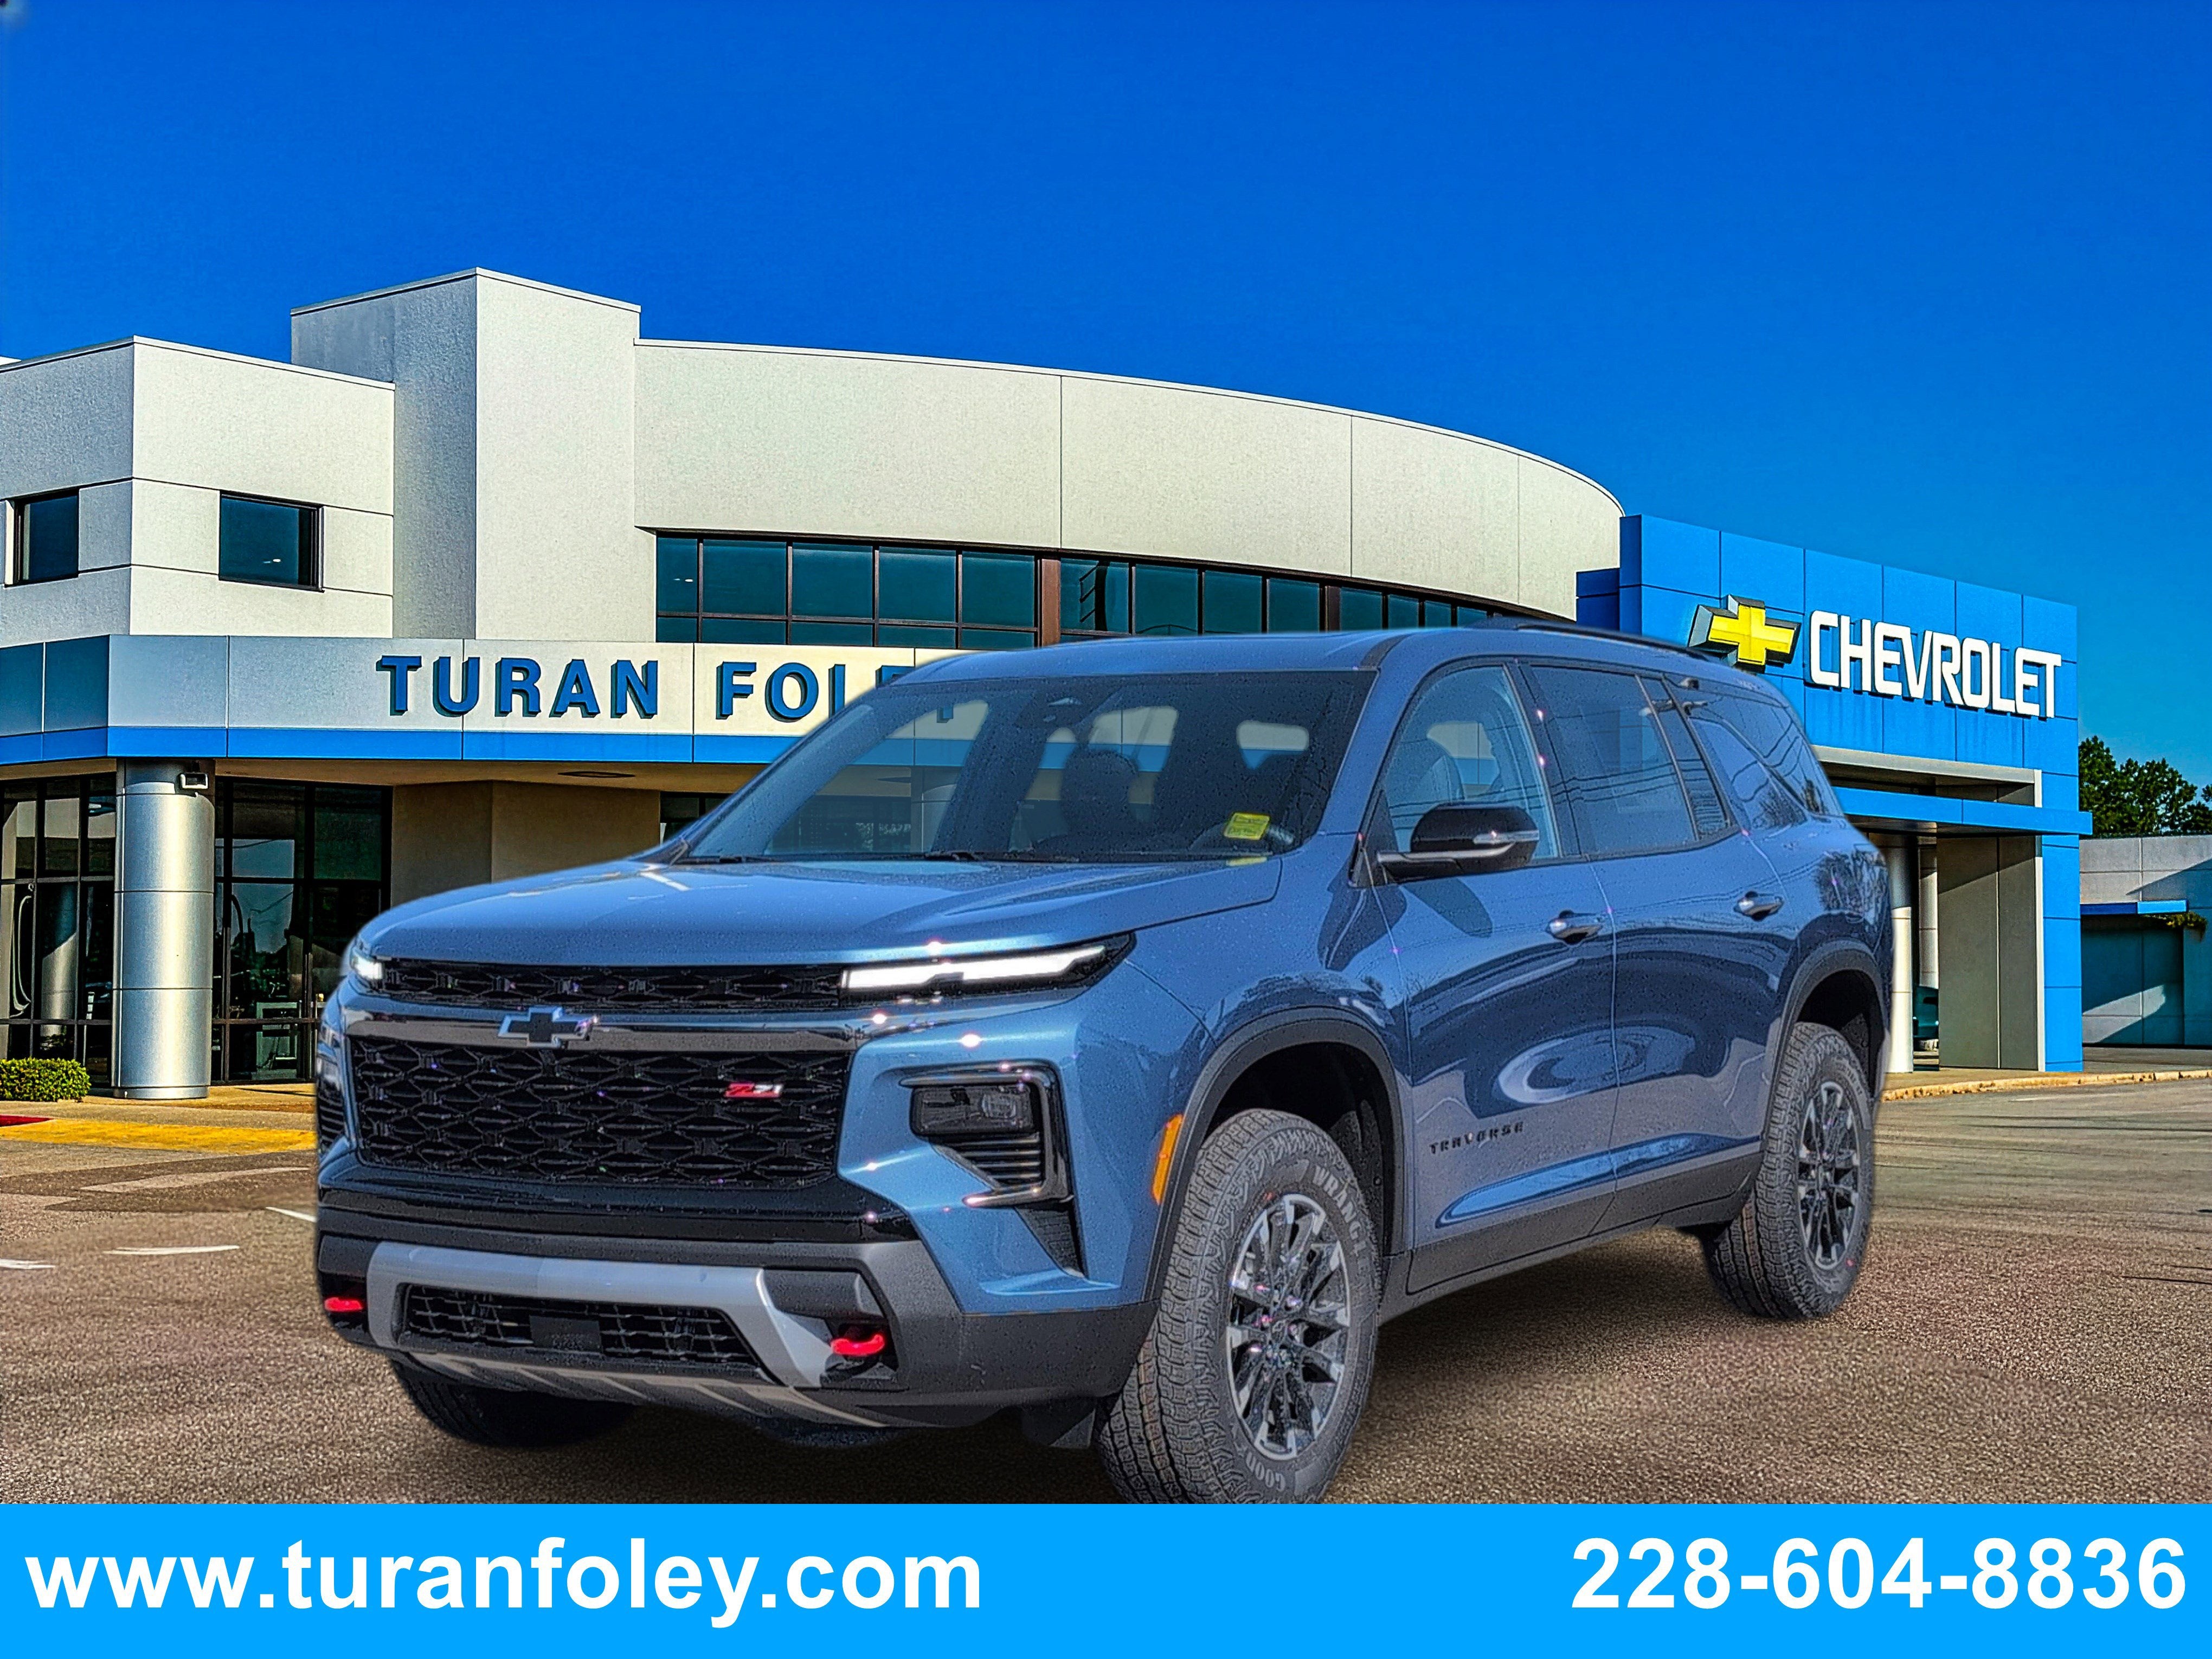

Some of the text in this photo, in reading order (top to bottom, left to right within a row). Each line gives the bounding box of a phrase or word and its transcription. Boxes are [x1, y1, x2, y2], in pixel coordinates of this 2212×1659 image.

[376, 655, 658, 719] TURAN
[1810, 609, 2062, 719] CHEVROLET
[1429, 1121, 1523, 1155] TRAVERSE
